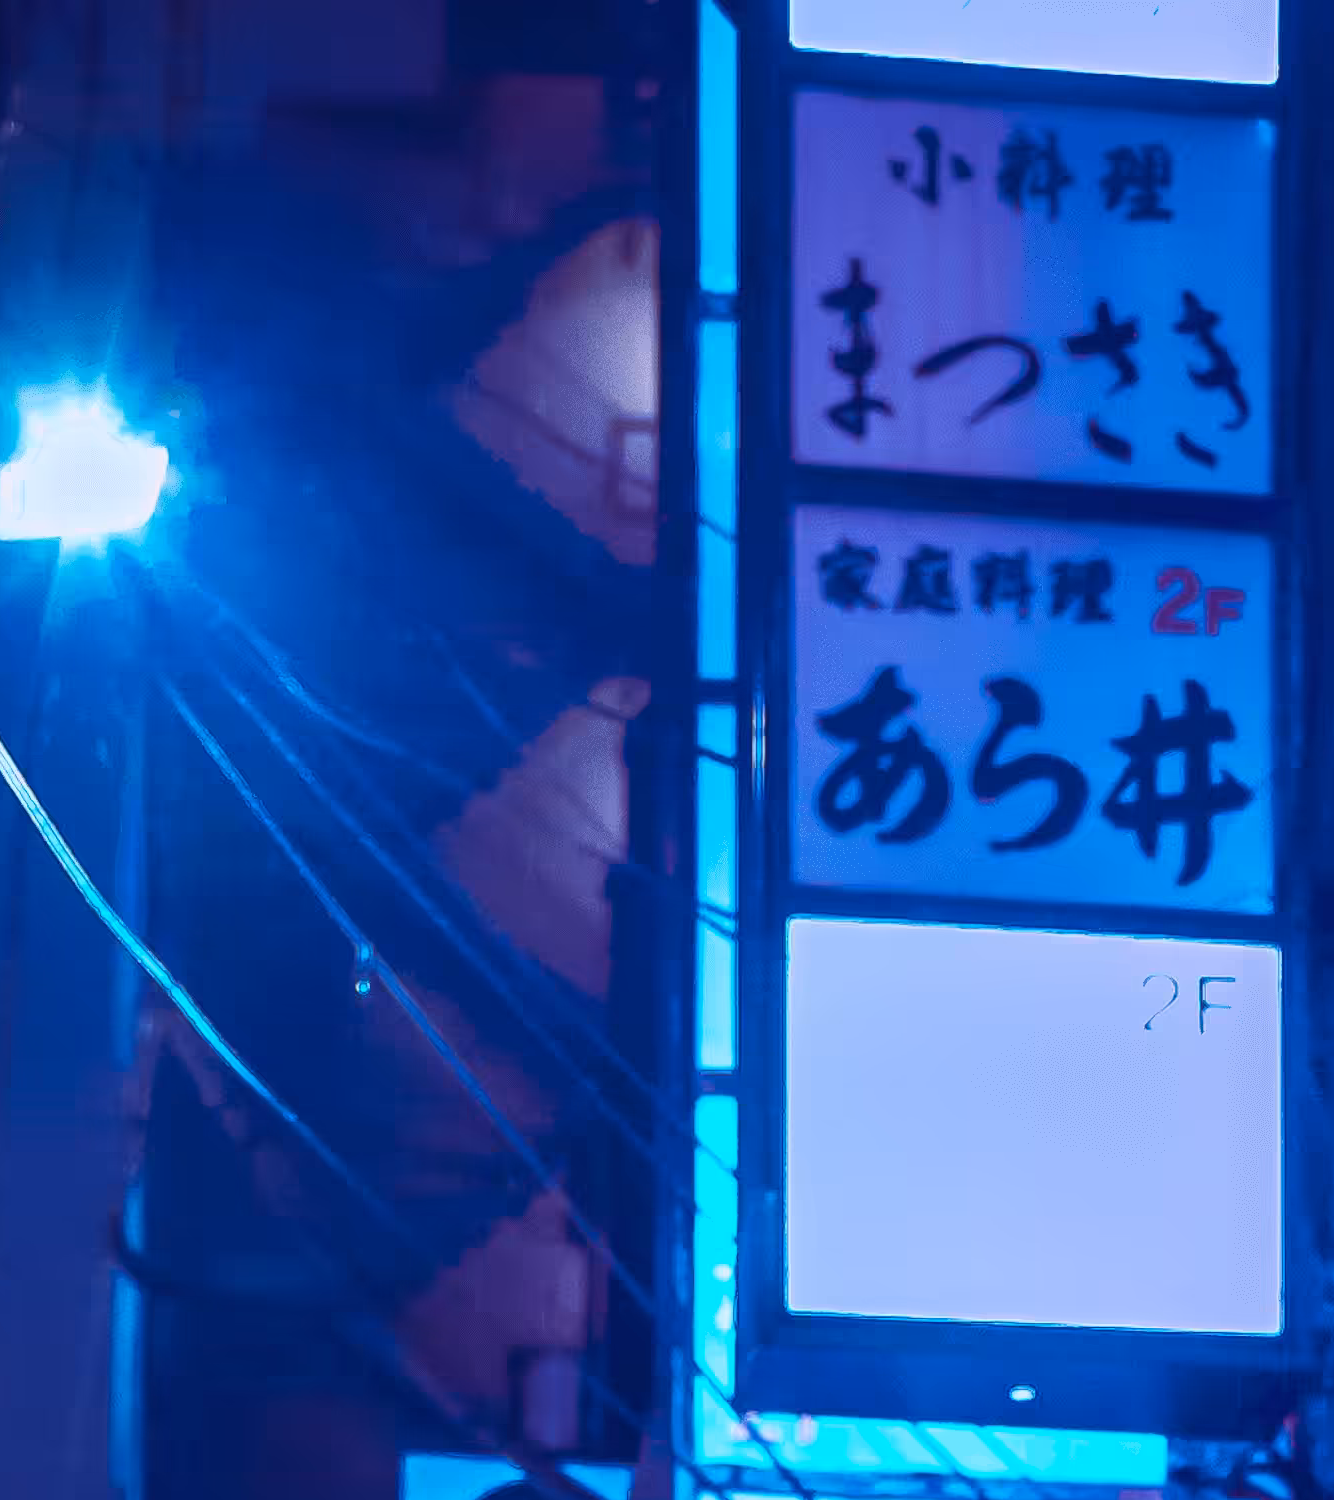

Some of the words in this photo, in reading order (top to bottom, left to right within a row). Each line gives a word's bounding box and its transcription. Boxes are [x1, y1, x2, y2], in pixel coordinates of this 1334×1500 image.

[888, 125, 1175, 223] 小料理
[817, 538, 1117, 624] 家庭料理
[1151, 567, 1246, 636] 2F
[814, 664, 1255, 887] あら井
[1140, 972, 1238, 1035] 2F
